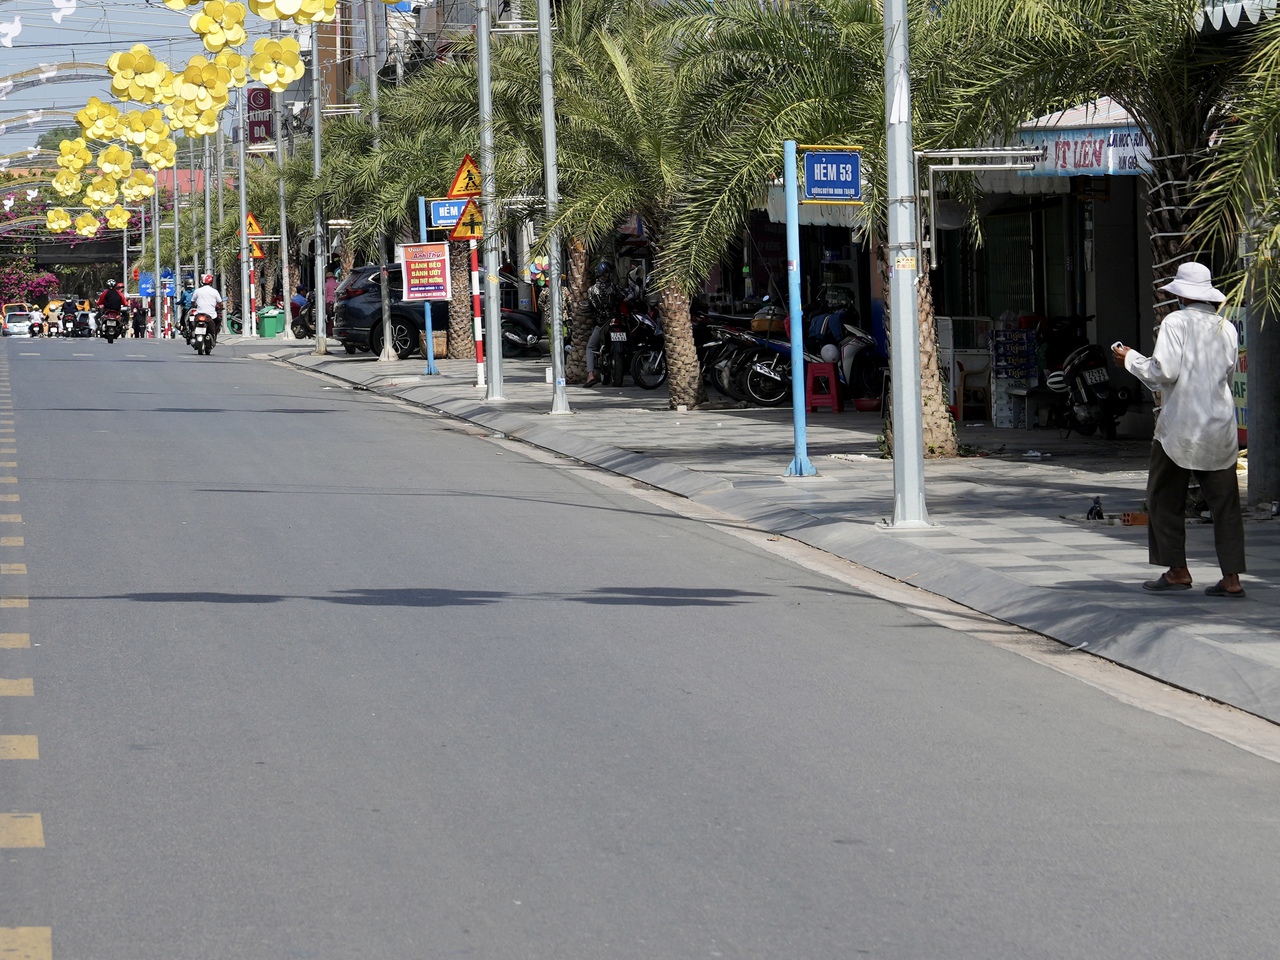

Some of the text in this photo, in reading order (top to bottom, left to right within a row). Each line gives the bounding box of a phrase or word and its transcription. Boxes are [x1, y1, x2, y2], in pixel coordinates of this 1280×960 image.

[814, 157, 852, 181] HẺM 53
[439, 204, 459, 217] HẺM
